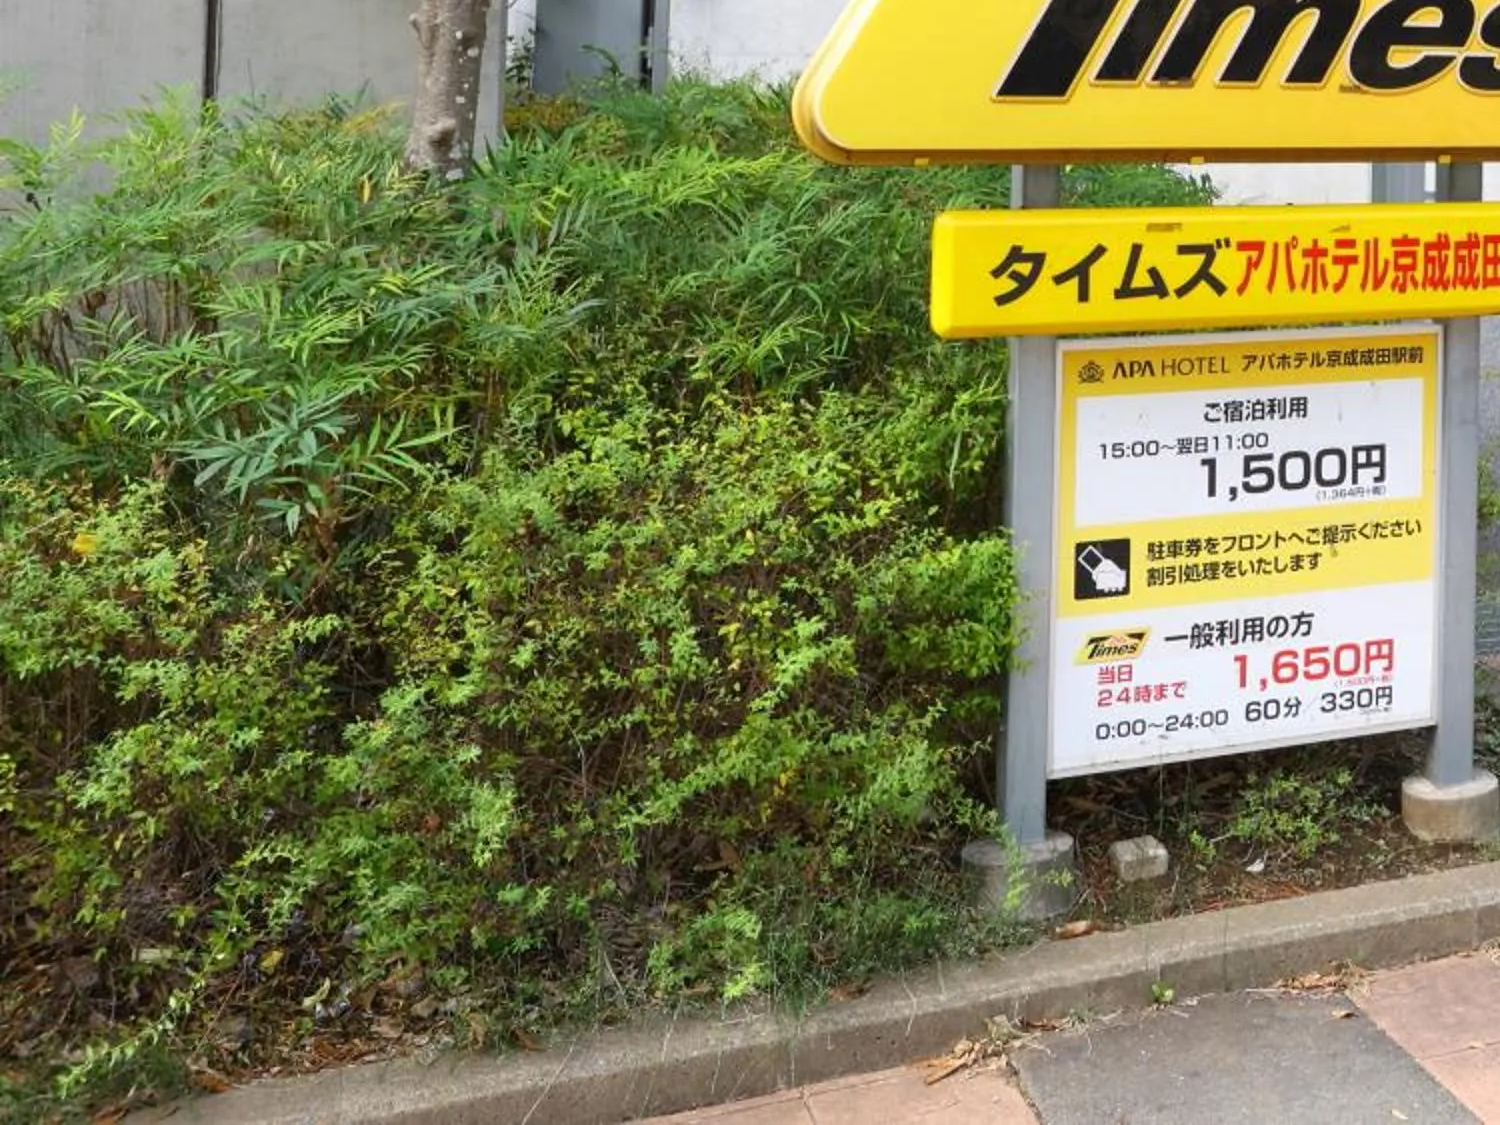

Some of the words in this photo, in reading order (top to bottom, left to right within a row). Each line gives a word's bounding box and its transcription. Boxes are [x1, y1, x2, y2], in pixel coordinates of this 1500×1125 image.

[1112, 359, 1155, 379] APA
[1161, 356, 1230, 377] HOTEL
[1203, 396, 1309, 424] ご宿泊利用
[1200, 443, 1387, 502] 1,500円
[1147, 518, 1422, 562] 駐車券をフロントへご提示ください
[1146, 552, 1322, 588] 割引処理をいたします
[1164, 611, 1315, 651] 一般利用の方
[1088, 642, 1139, 660] Times
[1233, 638, 1394, 692] 1,650円
[1097, 663, 1133, 685] 当日
[1097, 680, 1187, 708] 24時まで
[1245, 696, 1302, 722] 60分
[1321, 685, 1393, 713] 330円
